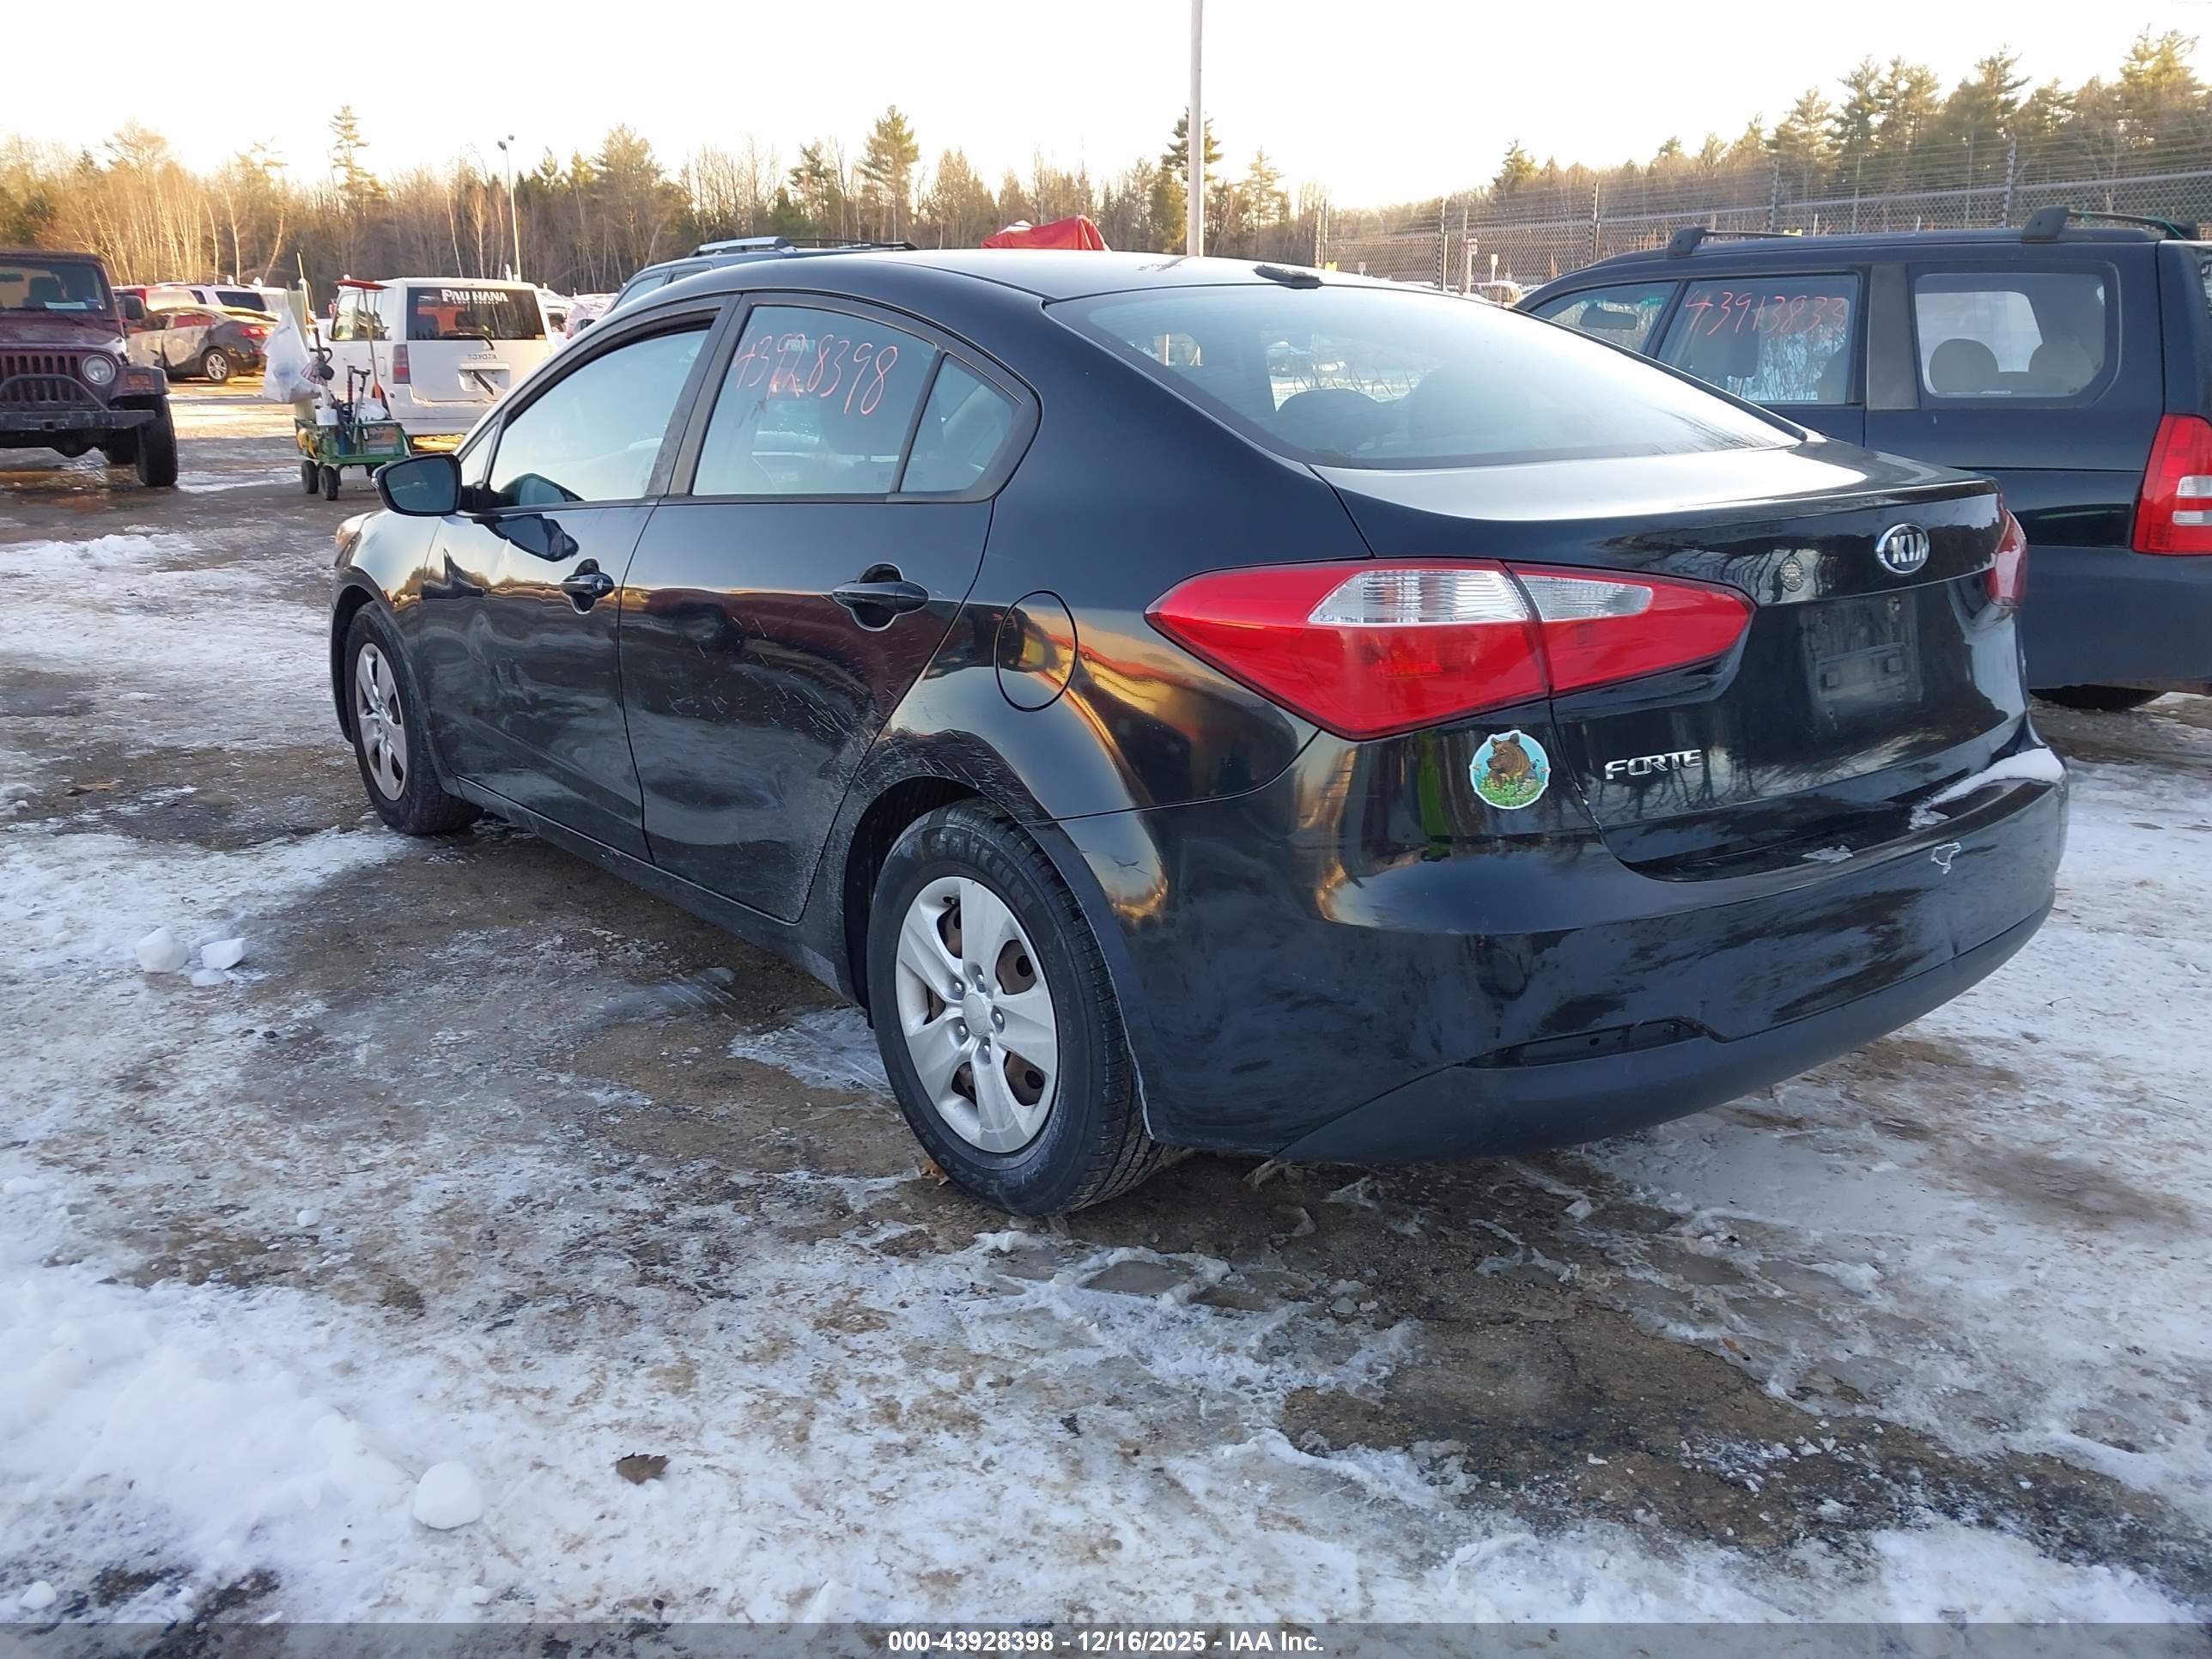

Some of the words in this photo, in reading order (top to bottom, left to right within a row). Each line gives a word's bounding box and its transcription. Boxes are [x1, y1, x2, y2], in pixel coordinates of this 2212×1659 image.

[1685, 289, 1846, 336] 43913833
[733, 325, 899, 415] 43928398
[1604, 749, 1705, 780] FORTE
